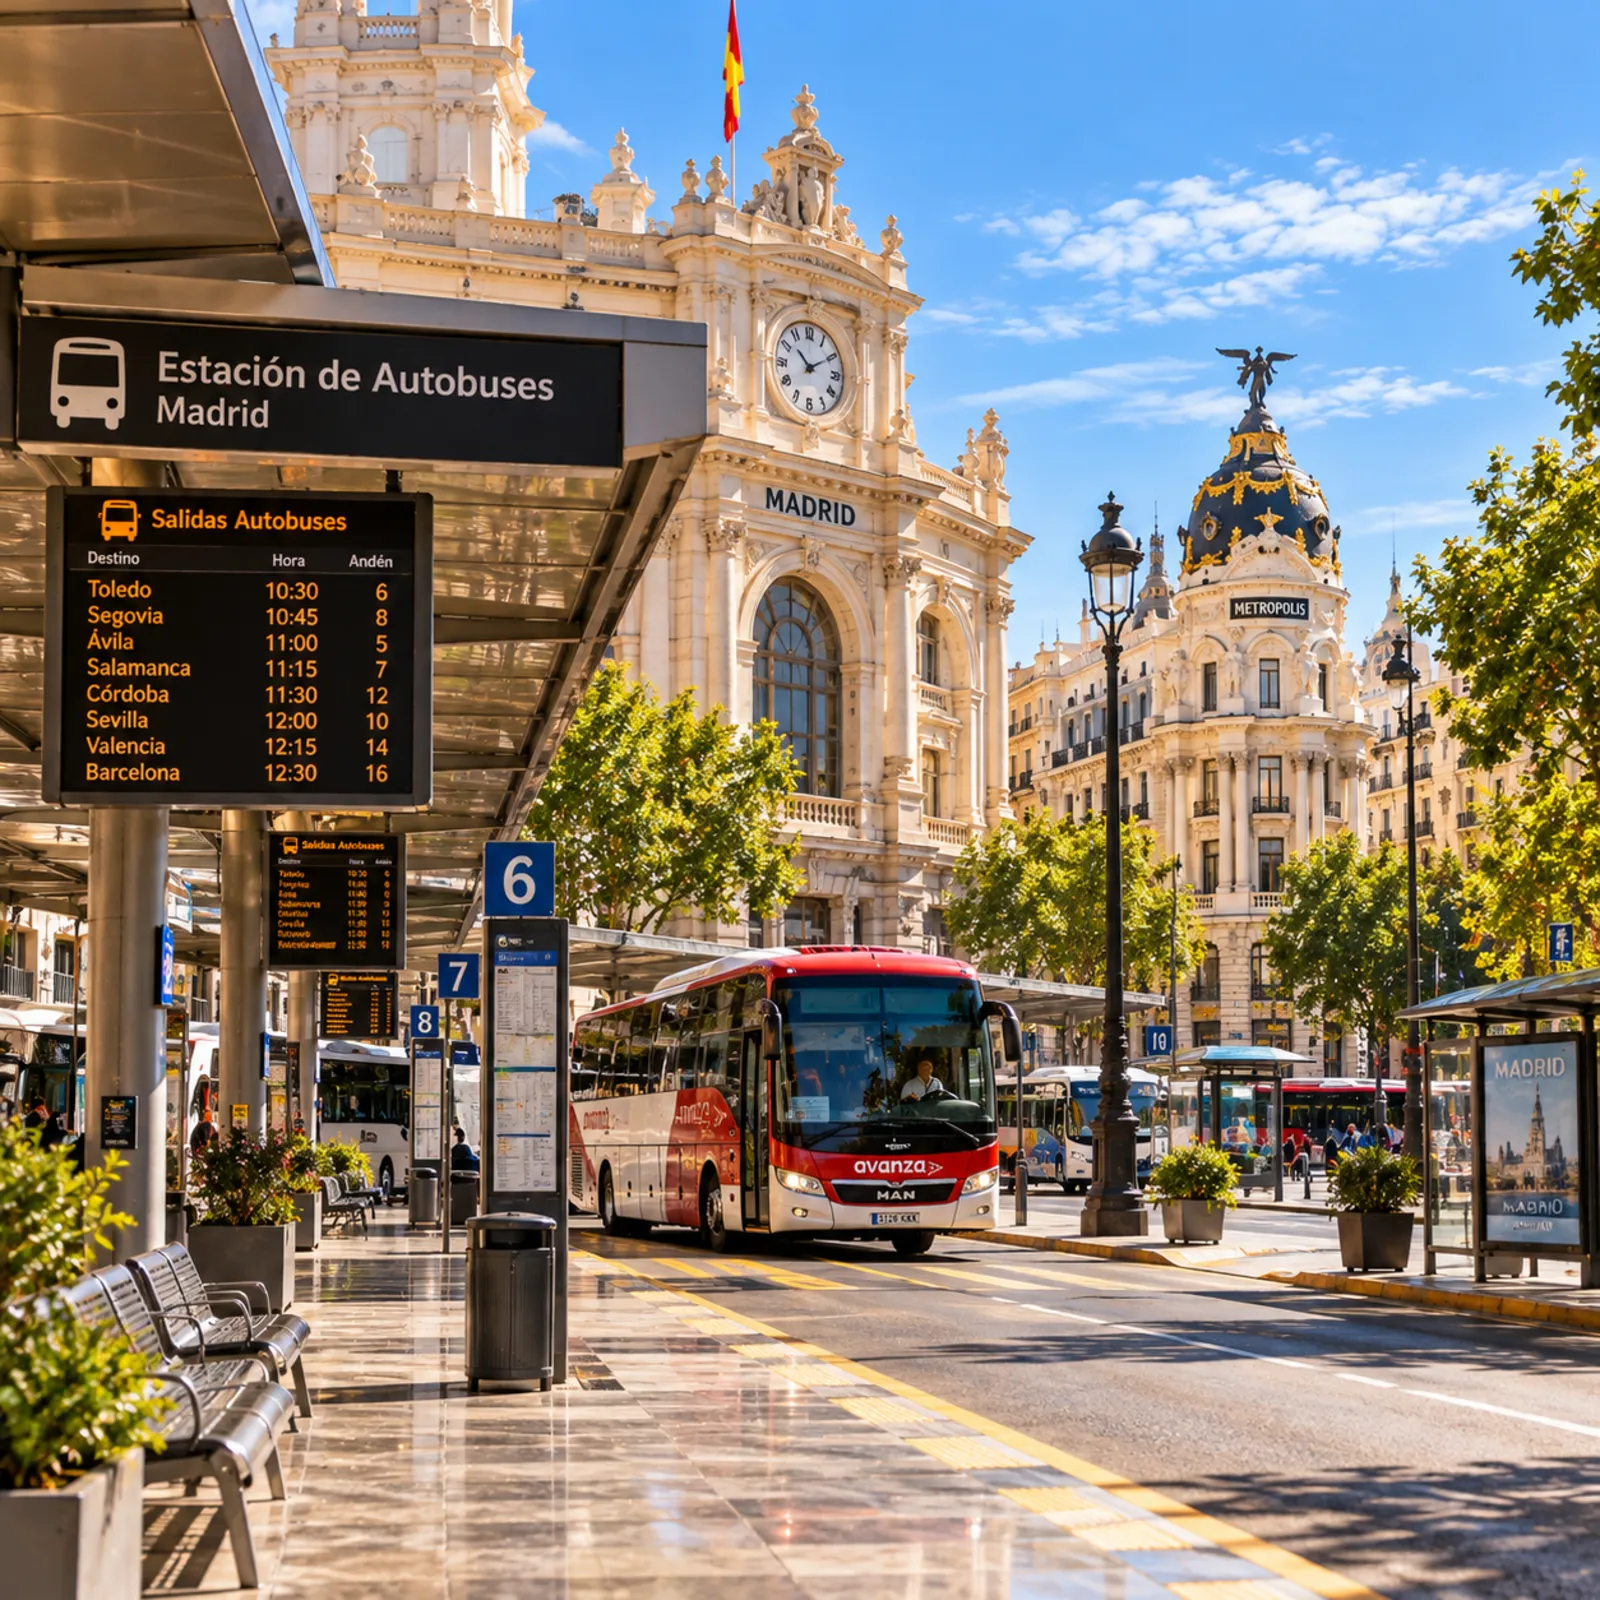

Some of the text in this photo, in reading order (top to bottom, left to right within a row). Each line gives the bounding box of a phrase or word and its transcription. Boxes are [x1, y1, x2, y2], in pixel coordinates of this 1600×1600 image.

[159, 351, 553, 400] Estación de Autobuses
[158, 396, 268, 428] Madrid
[766, 487, 855, 526] MADRID
[152, 509, 346, 530] Salidas Autobuses
[88, 551, 392, 567] Destino Hora Andén
[88, 580, 388, 601] Toledo 10:30 6
[88, 606, 387, 628] Segovia 10:45 8
[1235, 602, 1305, 615] METROPOLIS
[87, 631, 387, 652] Ávila 11:00 5
[88, 658, 387, 678] Salamanca 11:15 7
[87, 684, 388, 704] Córdoba 11:30 12
[87, 710, 388, 730] Sevilla 12:00 10
[86, 736, 388, 755] Valencia 12:15 14
[87, 763, 388, 782] Barcelona 12:30 16
[504, 856, 535, 904] 6
[449, 961, 468, 992] 7
[418, 1011, 432, 1033] 8
[1153, 1032, 1167, 1051] 10
[1495, 1057, 1565, 1079] MADRID
[854, 1160, 926, 1173] avanza
[877, 1191, 915, 1200] MAN
